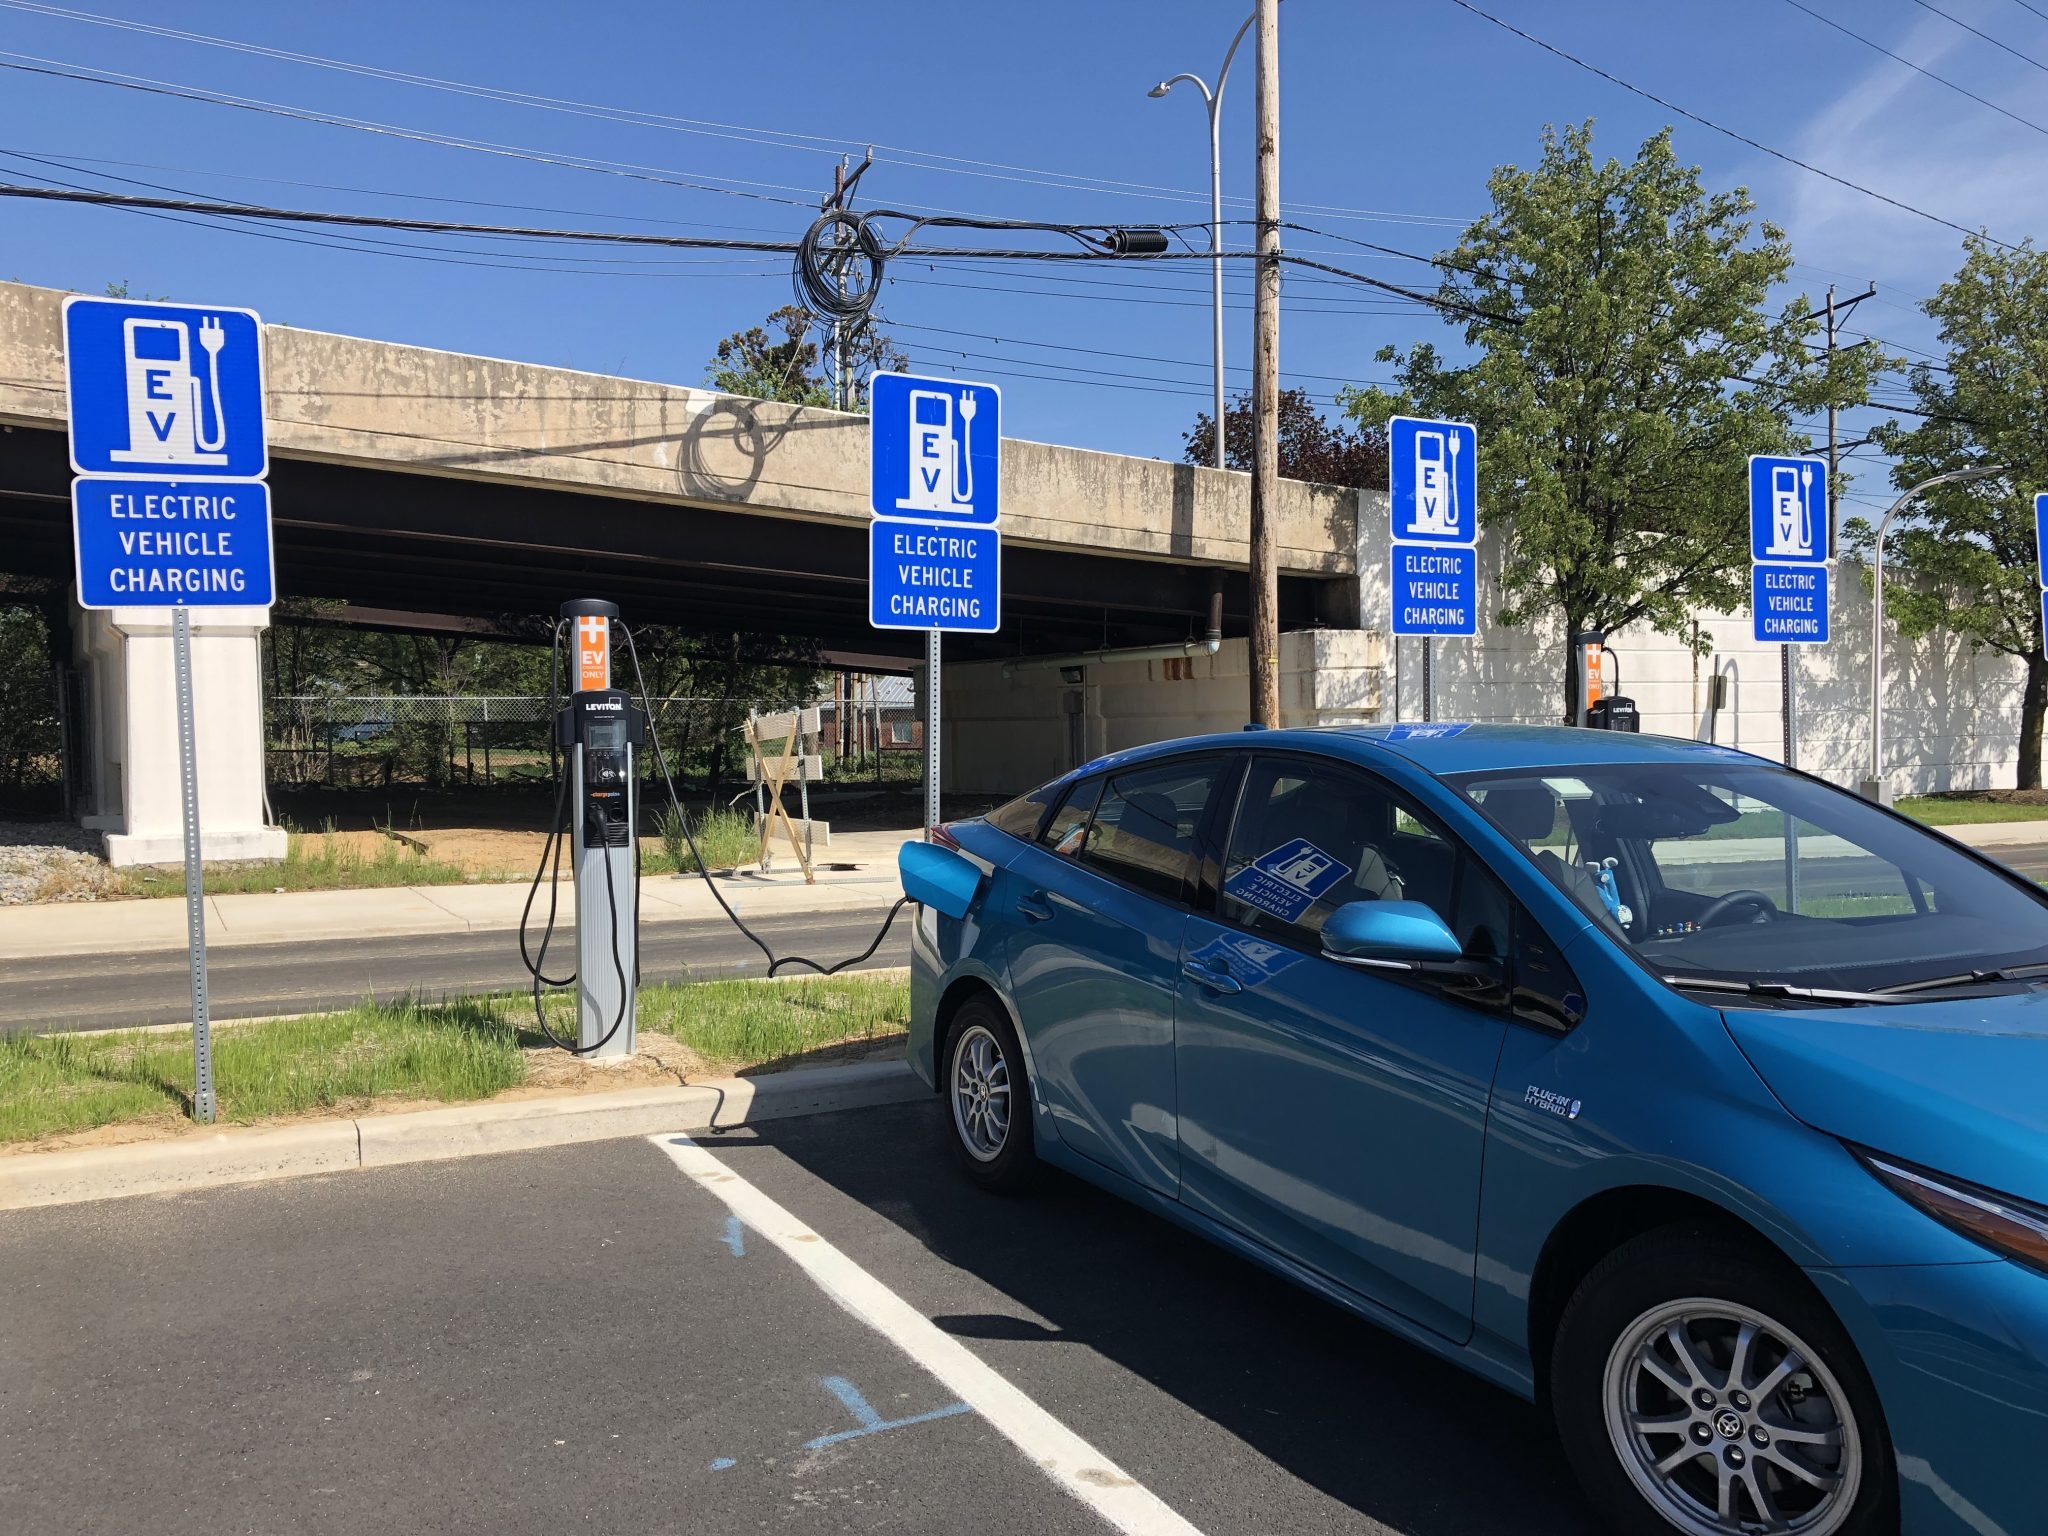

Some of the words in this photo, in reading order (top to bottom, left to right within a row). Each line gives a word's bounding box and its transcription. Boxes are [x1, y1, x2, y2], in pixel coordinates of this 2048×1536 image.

[146, 369, 176, 442] EV
[921, 432, 940, 493] EV
[110, 494, 236, 520] ELECTRIC
[119, 531, 233, 556] VEHICLE
[894, 534, 977, 559] ELECTRIC
[1406, 555, 1462, 575] ELECTRIC
[110, 567, 246, 592] CHARGING
[898, 565, 973, 589] VEHICLE
[1765, 573, 1816, 590] ELECTRIC
[1409, 581, 1459, 600] VEHICLE
[890, 594, 981, 618] CHARGING
[1768, 596, 1813, 612] VEHICLE
[1404, 607, 1464, 625] CHARGING
[1764, 618, 1818, 634] CHARGING
[582, 651, 604, 665] EV
[582, 670, 604, 679] ONLY
[1588, 669, 1600, 680] EV
[585, 703, 622, 711] LEVITON
[1524, 1093, 1565, 1116] HYBRID
